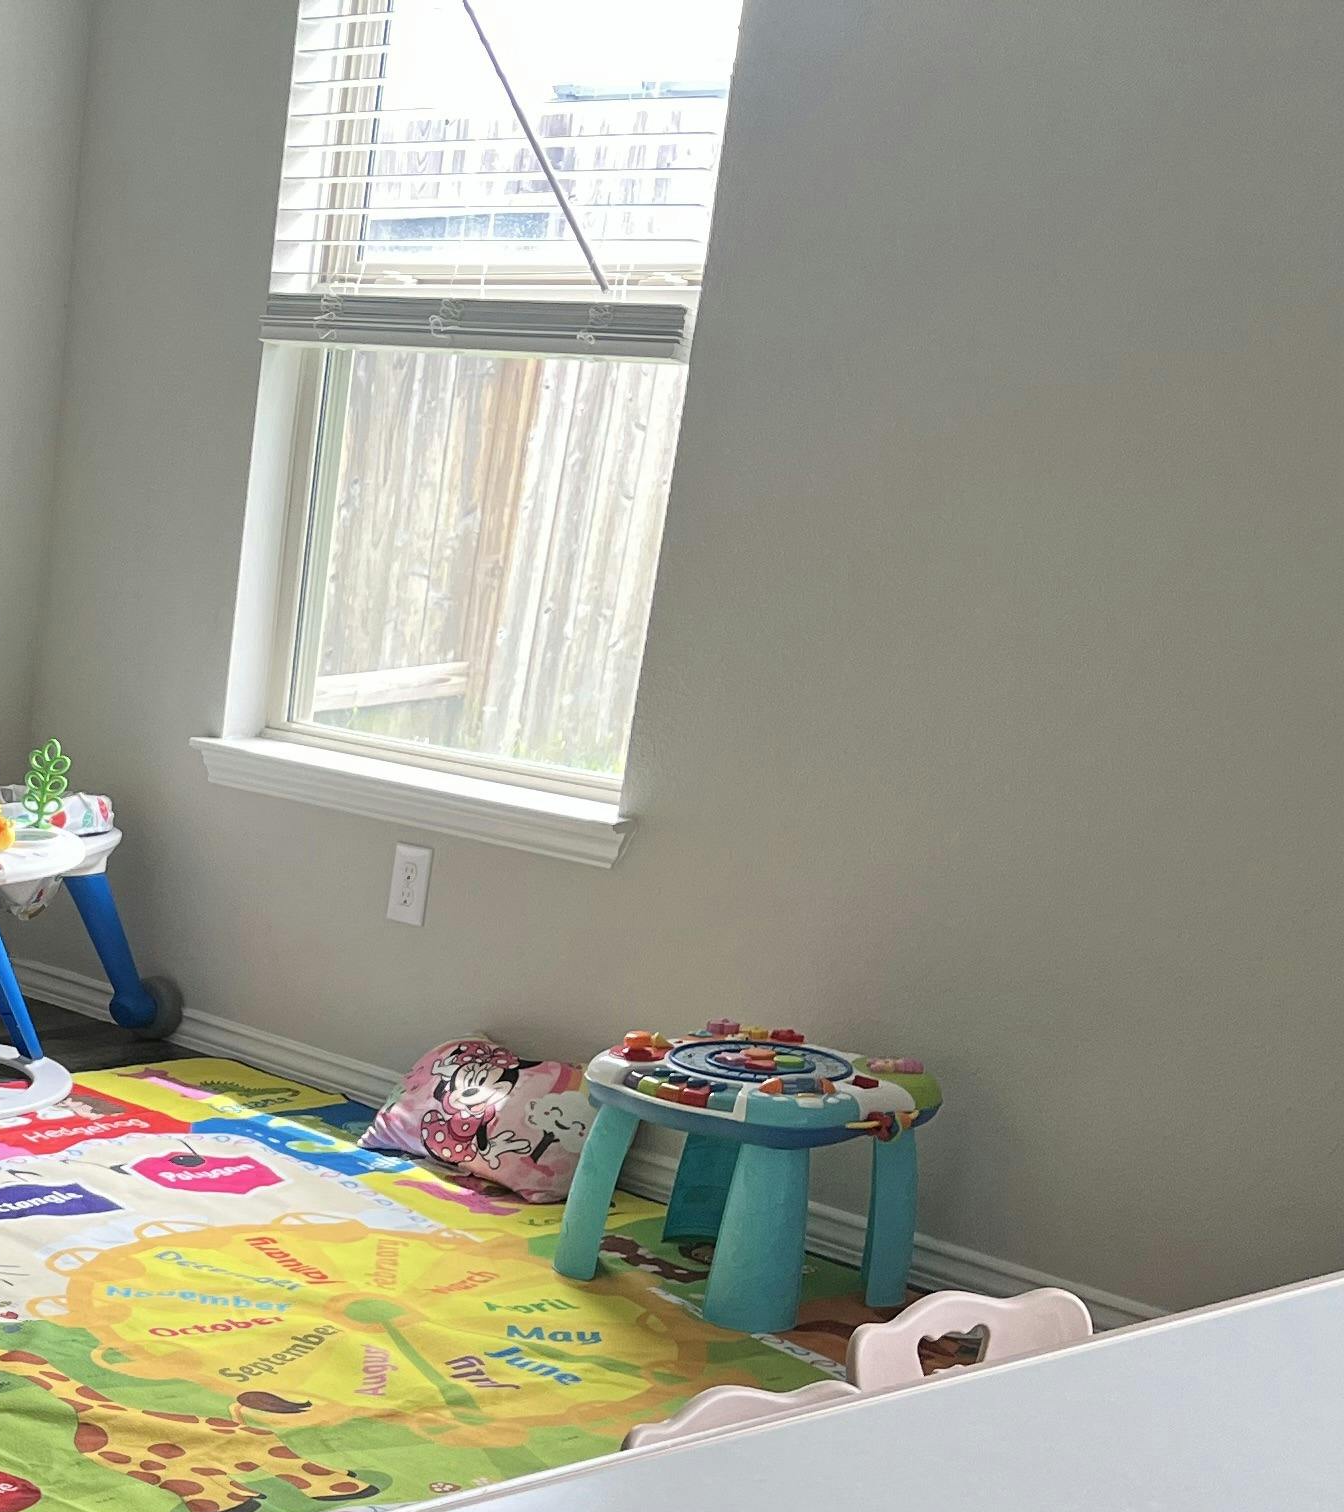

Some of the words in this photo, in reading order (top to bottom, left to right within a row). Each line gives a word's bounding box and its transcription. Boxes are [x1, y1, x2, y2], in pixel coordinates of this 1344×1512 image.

[22, 1116, 151, 1143] Hedgehog
[157, 1163, 256, 1187] Polygon
[243, 1236, 349, 1285] January
[148, 1315, 286, 1338] October
[506, 1324, 602, 1346] May
[217, 1323, 346, 1384] September
[482, 1345, 584, 1386] June
